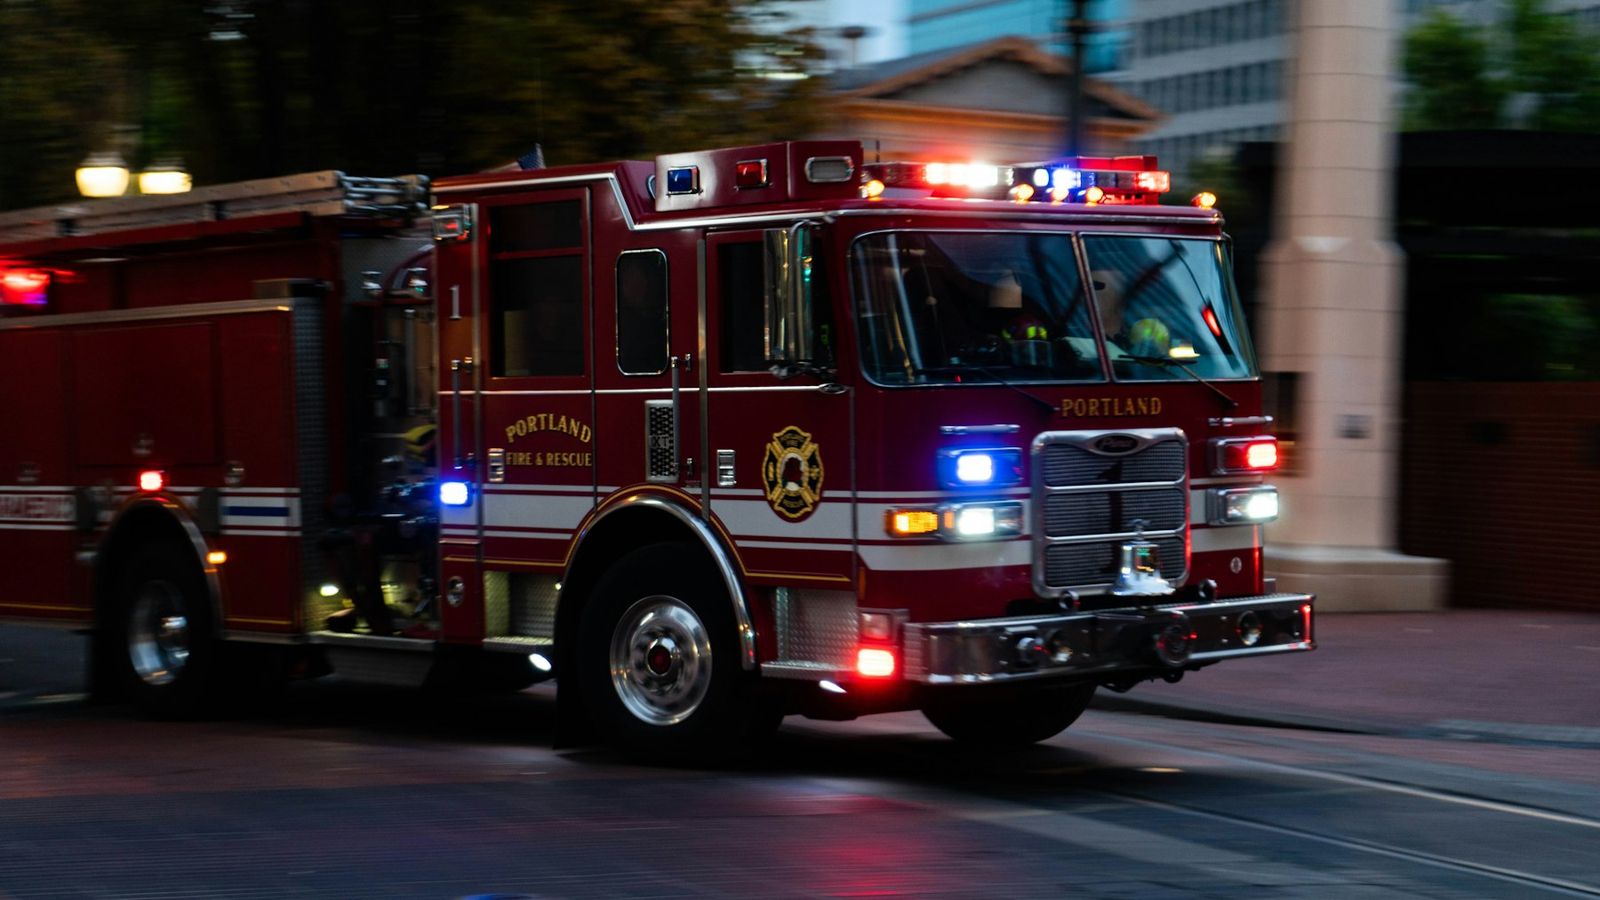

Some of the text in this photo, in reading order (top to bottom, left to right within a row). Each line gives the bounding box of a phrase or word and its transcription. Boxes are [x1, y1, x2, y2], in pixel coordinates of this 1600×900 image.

[448, 283, 463, 320] 1
[1061, 397, 1162, 417] PORTLAND
[505, 413, 592, 444] PORTLAND
[506, 452, 592, 467] FIRE & RESCUE
